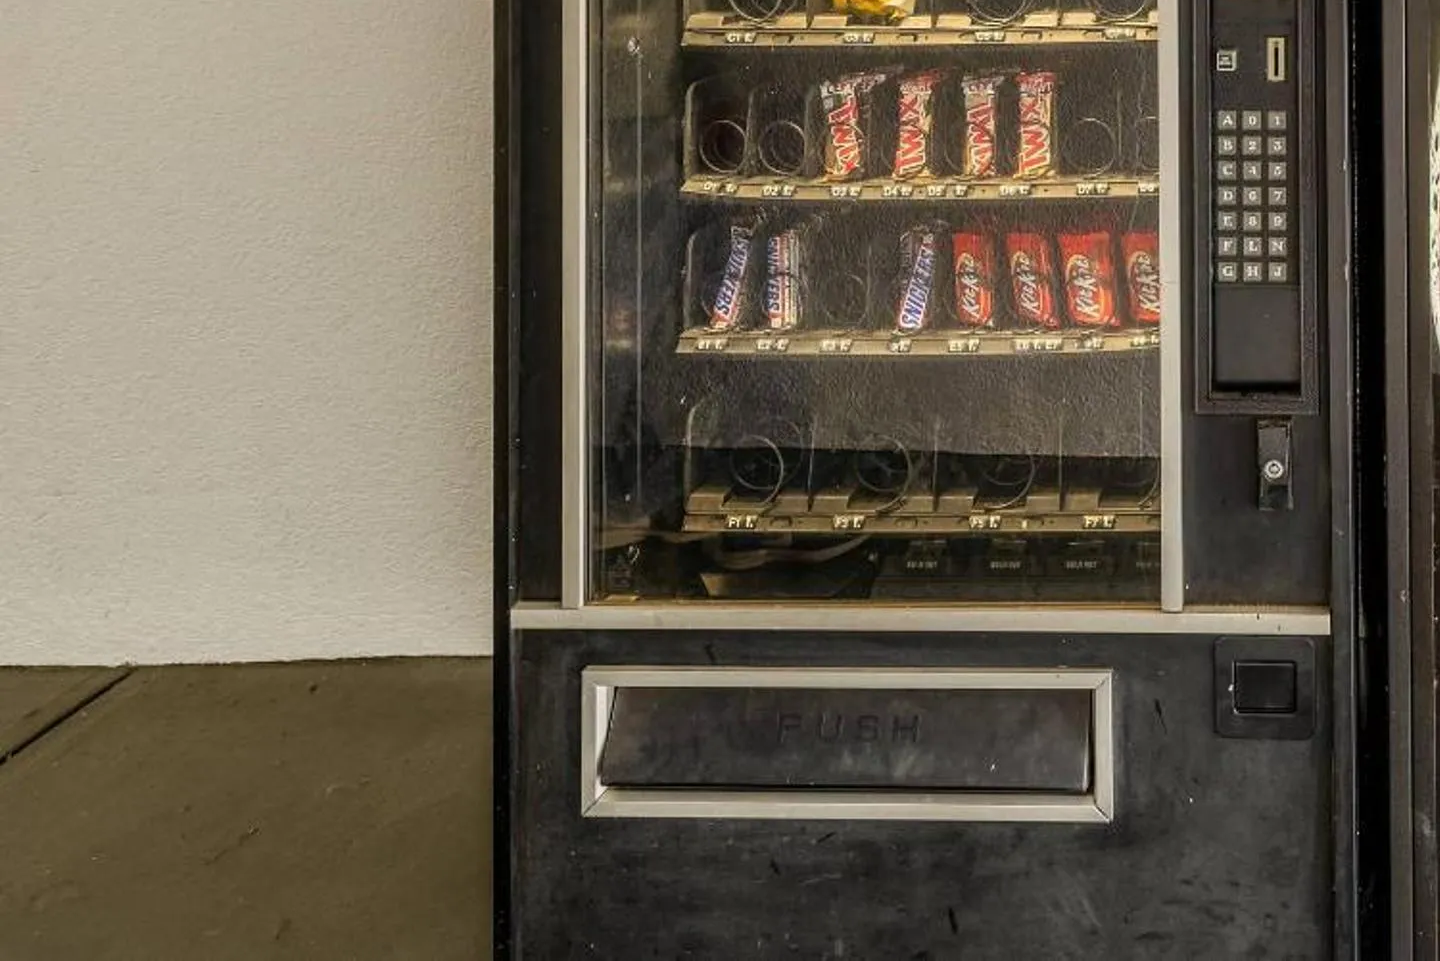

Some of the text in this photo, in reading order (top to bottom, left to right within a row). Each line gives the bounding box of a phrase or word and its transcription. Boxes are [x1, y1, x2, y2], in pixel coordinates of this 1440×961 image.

[1223, 115, 1234, 126] A
[1247, 115, 1258, 126] 0
[1223, 140, 1234, 151] B
[1247, 140, 1258, 151] 2
[1272, 140, 1283, 151] 3
[1223, 165, 1234, 176] C
[1223, 190, 1234, 201] D
[1247, 190, 1258, 201] 6
[1272, 190, 1283, 201] 7
[1223, 215, 1234, 226] E
[1223, 240, 1234, 251] F
[1223, 265, 1234, 276] G
[1247, 265, 1258, 276] H
[1272, 265, 1283, 276] J
[901, 245, 936, 328] SNICKERS
[778, 713, 921, 743] PUSH
